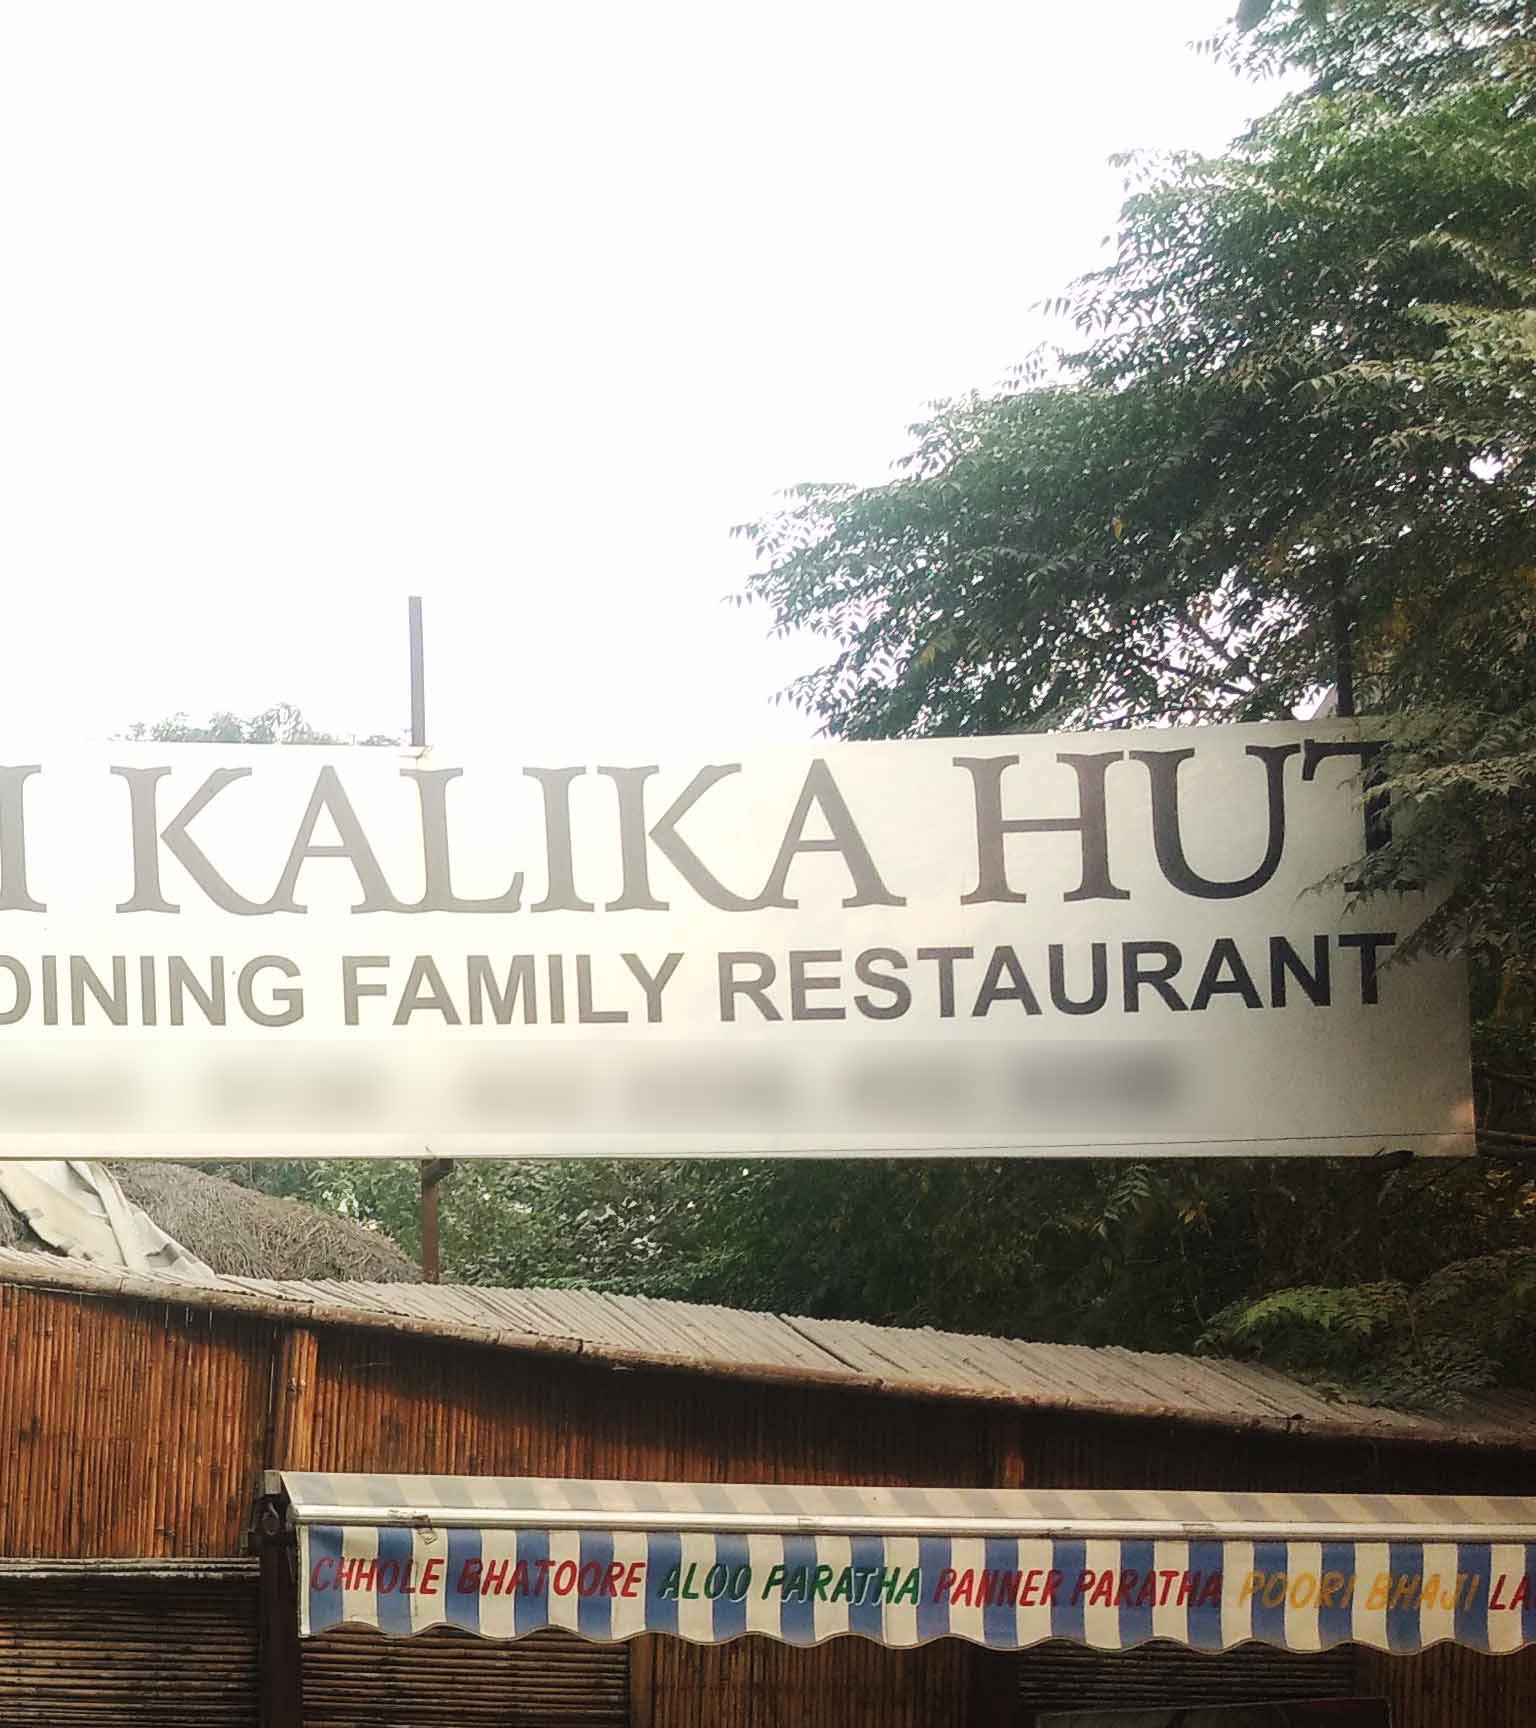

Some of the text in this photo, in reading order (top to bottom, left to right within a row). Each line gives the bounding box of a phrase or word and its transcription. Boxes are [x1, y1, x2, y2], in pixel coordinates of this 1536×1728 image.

[110, 758, 907, 916] KALIKA
[953, 738, 1426, 906] HUT
[341, 951, 685, 1027] FAMILY
[717, 932, 1397, 1023] RESTAURANT
[310, 1556, 443, 1596] CHHOLE
[457, 1557, 645, 1600] BHATOORE
[659, 1562, 752, 1602] ALOO
[762, 1563, 922, 1607] PARATHA
[934, 1568, 1064, 1608] PANNER
[1069, 1567, 1224, 1610] PARATHA
[1238, 1571, 1355, 1610] POORI
[1363, 1571, 1482, 1611] BHAJI
